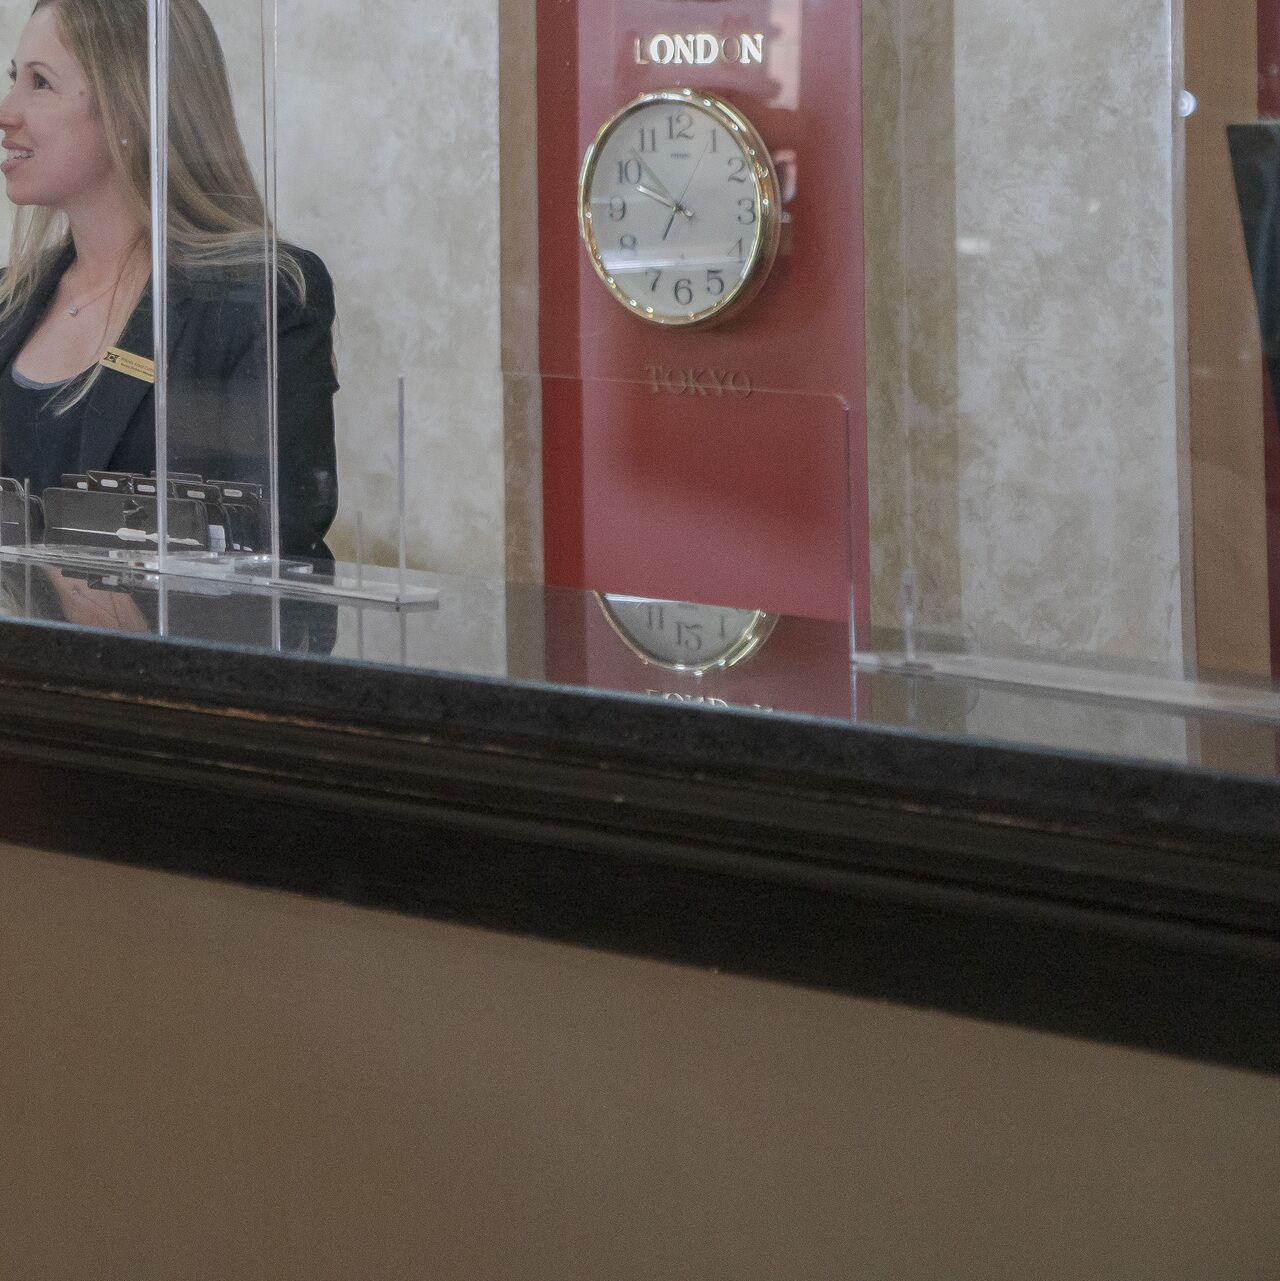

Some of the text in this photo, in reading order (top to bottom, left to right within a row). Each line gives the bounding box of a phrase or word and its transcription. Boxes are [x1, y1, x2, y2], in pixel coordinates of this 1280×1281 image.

[634, 33, 765, 65] LONDON
[667, 112, 694, 141] 12
[640, 127, 657, 152] 11
[710, 128, 718, 153] 1
[617, 159, 641, 184] 10
[728, 157, 746, 183] 2
[609, 196, 626, 221] 9
[737, 198, 756, 225] 3
[619, 234, 637, 257] 8
[645, 270, 663, 291] 7
[674, 279, 692, 305] 6
[706, 270, 724, 295] 5
[647, 365, 752, 400] TOKYO
